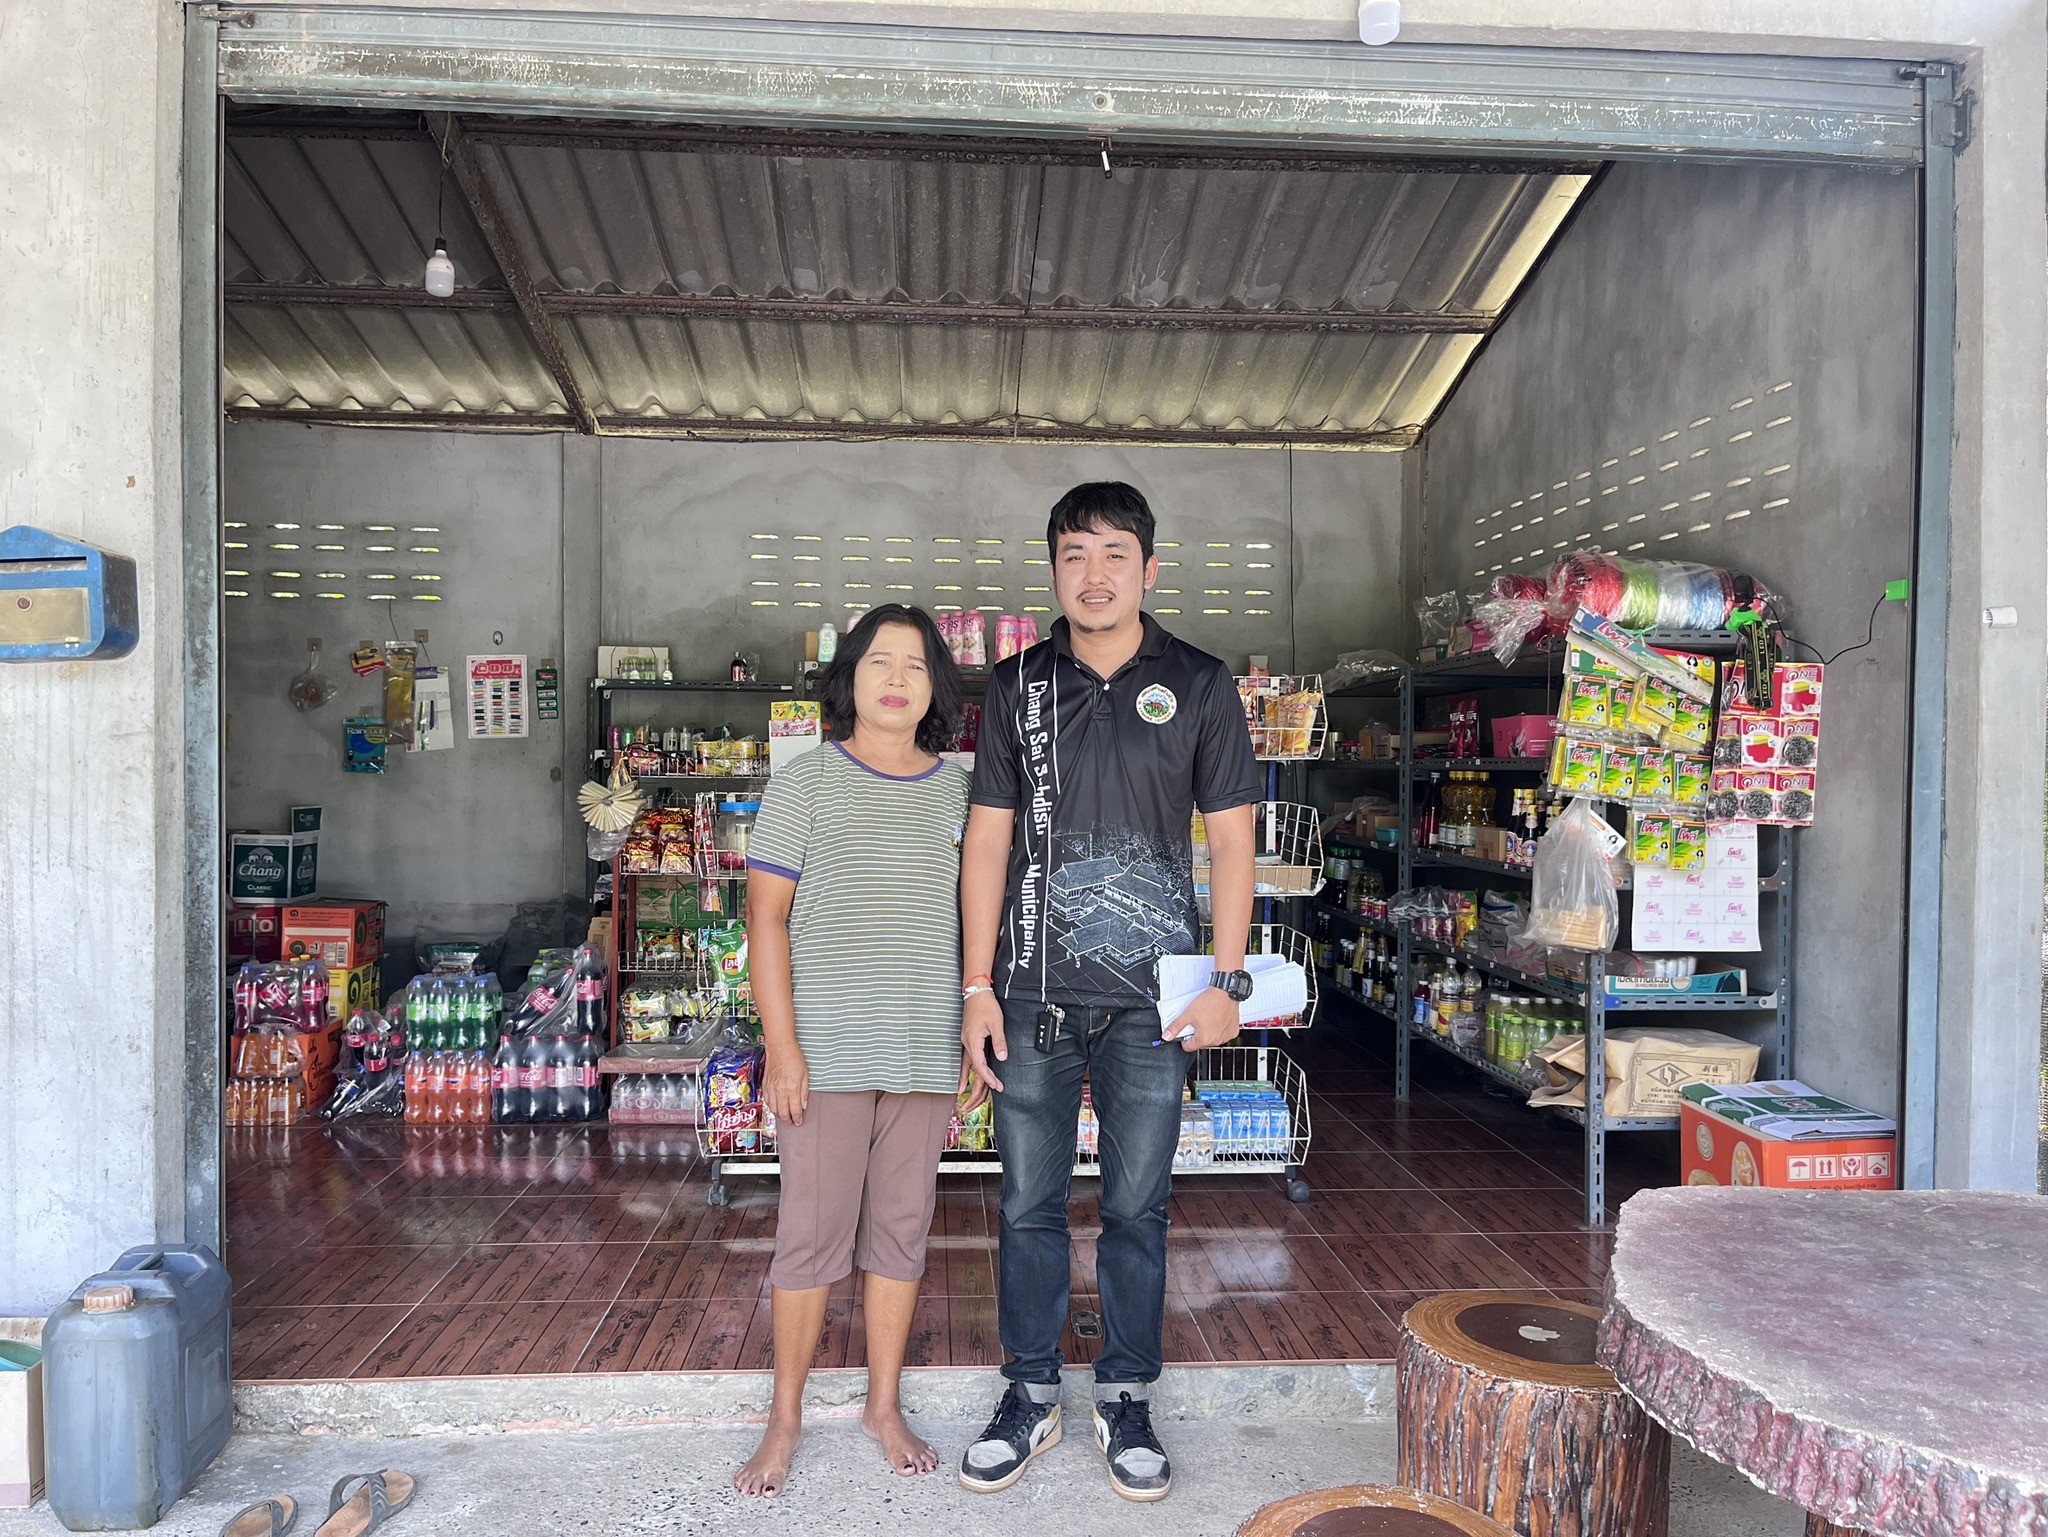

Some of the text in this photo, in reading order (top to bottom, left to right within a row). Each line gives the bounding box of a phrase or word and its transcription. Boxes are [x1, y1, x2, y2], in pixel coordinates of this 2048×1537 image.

[1025, 680, 1048, 731] Chang
[1030, 731, 1048, 761] Sai
[239, 863, 282, 879] Chang
[1017, 863, 1042, 969] Municipality
